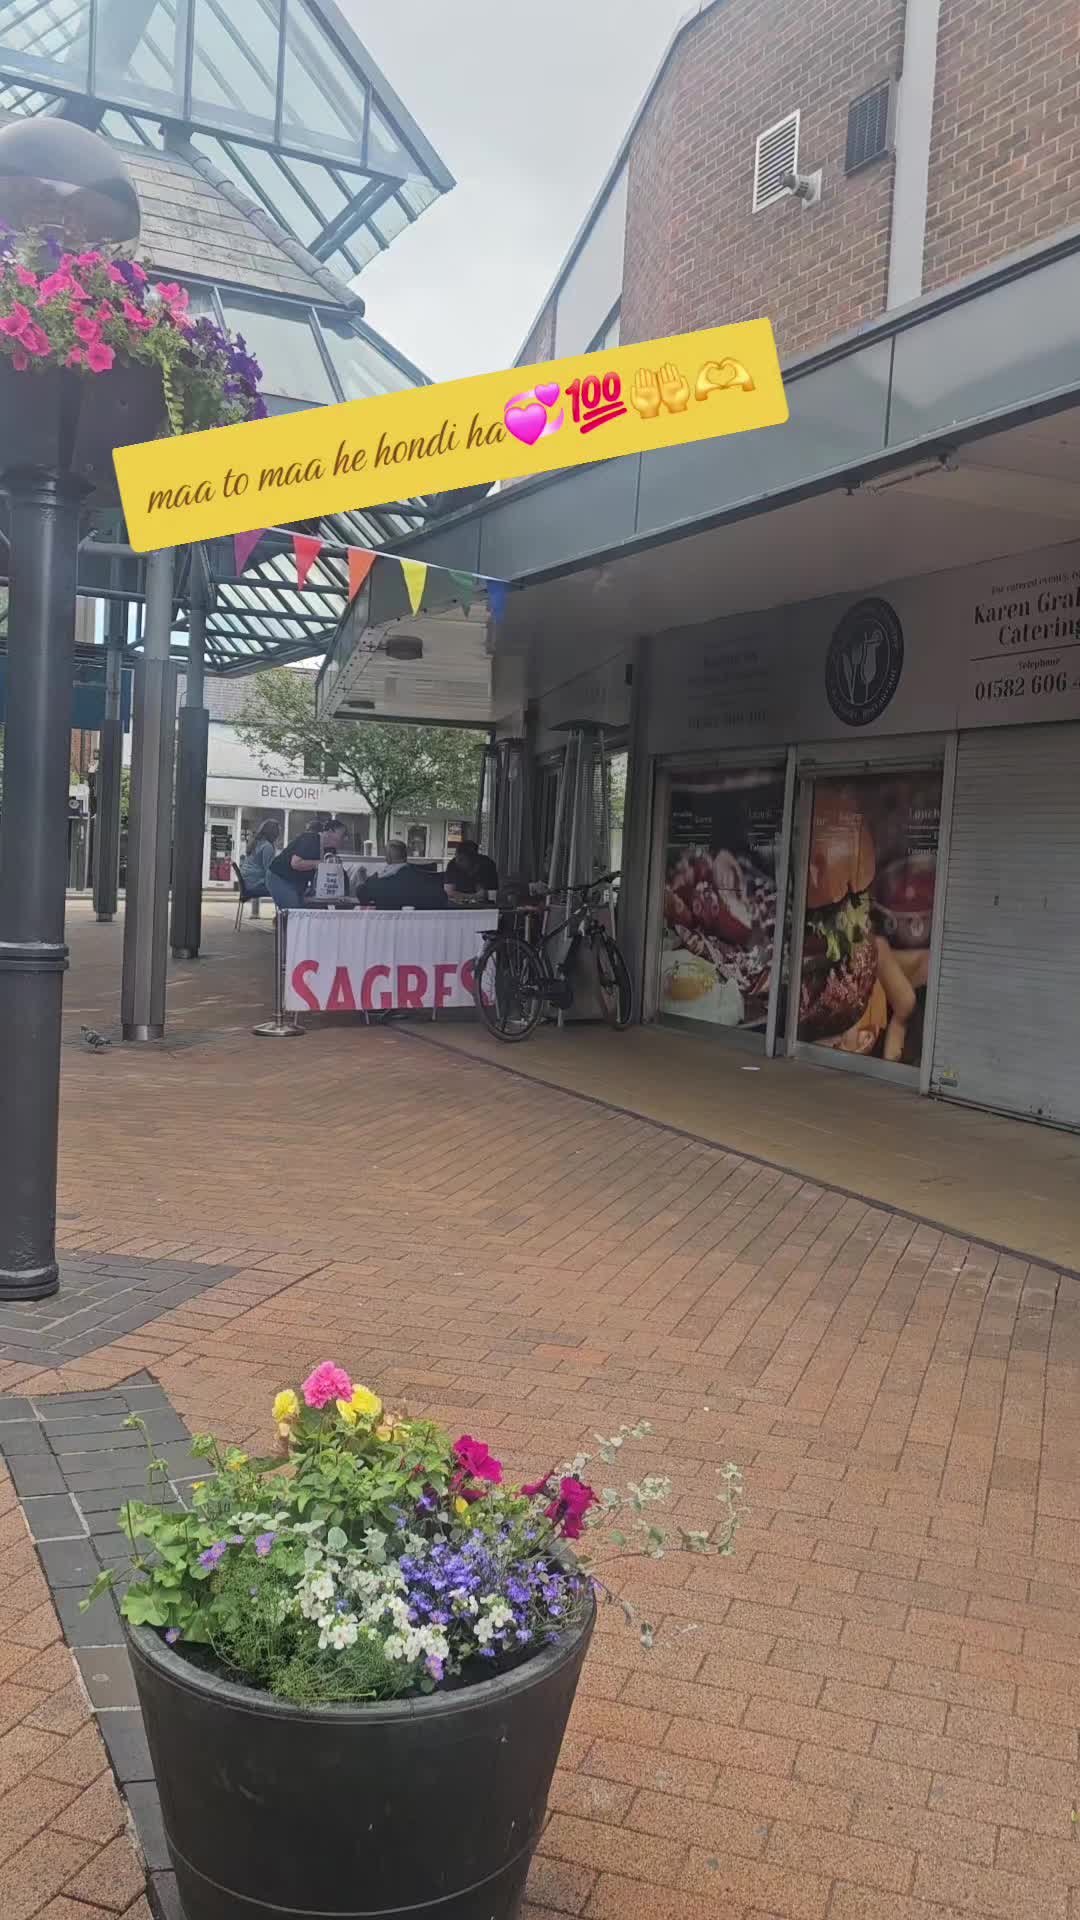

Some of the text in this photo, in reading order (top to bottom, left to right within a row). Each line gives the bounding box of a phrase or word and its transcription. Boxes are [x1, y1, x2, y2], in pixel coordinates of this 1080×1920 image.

[975, 600, 1030, 625] Karen
[975, 678, 1025, 702] 01582
[1031, 671, 1068, 695] 606
